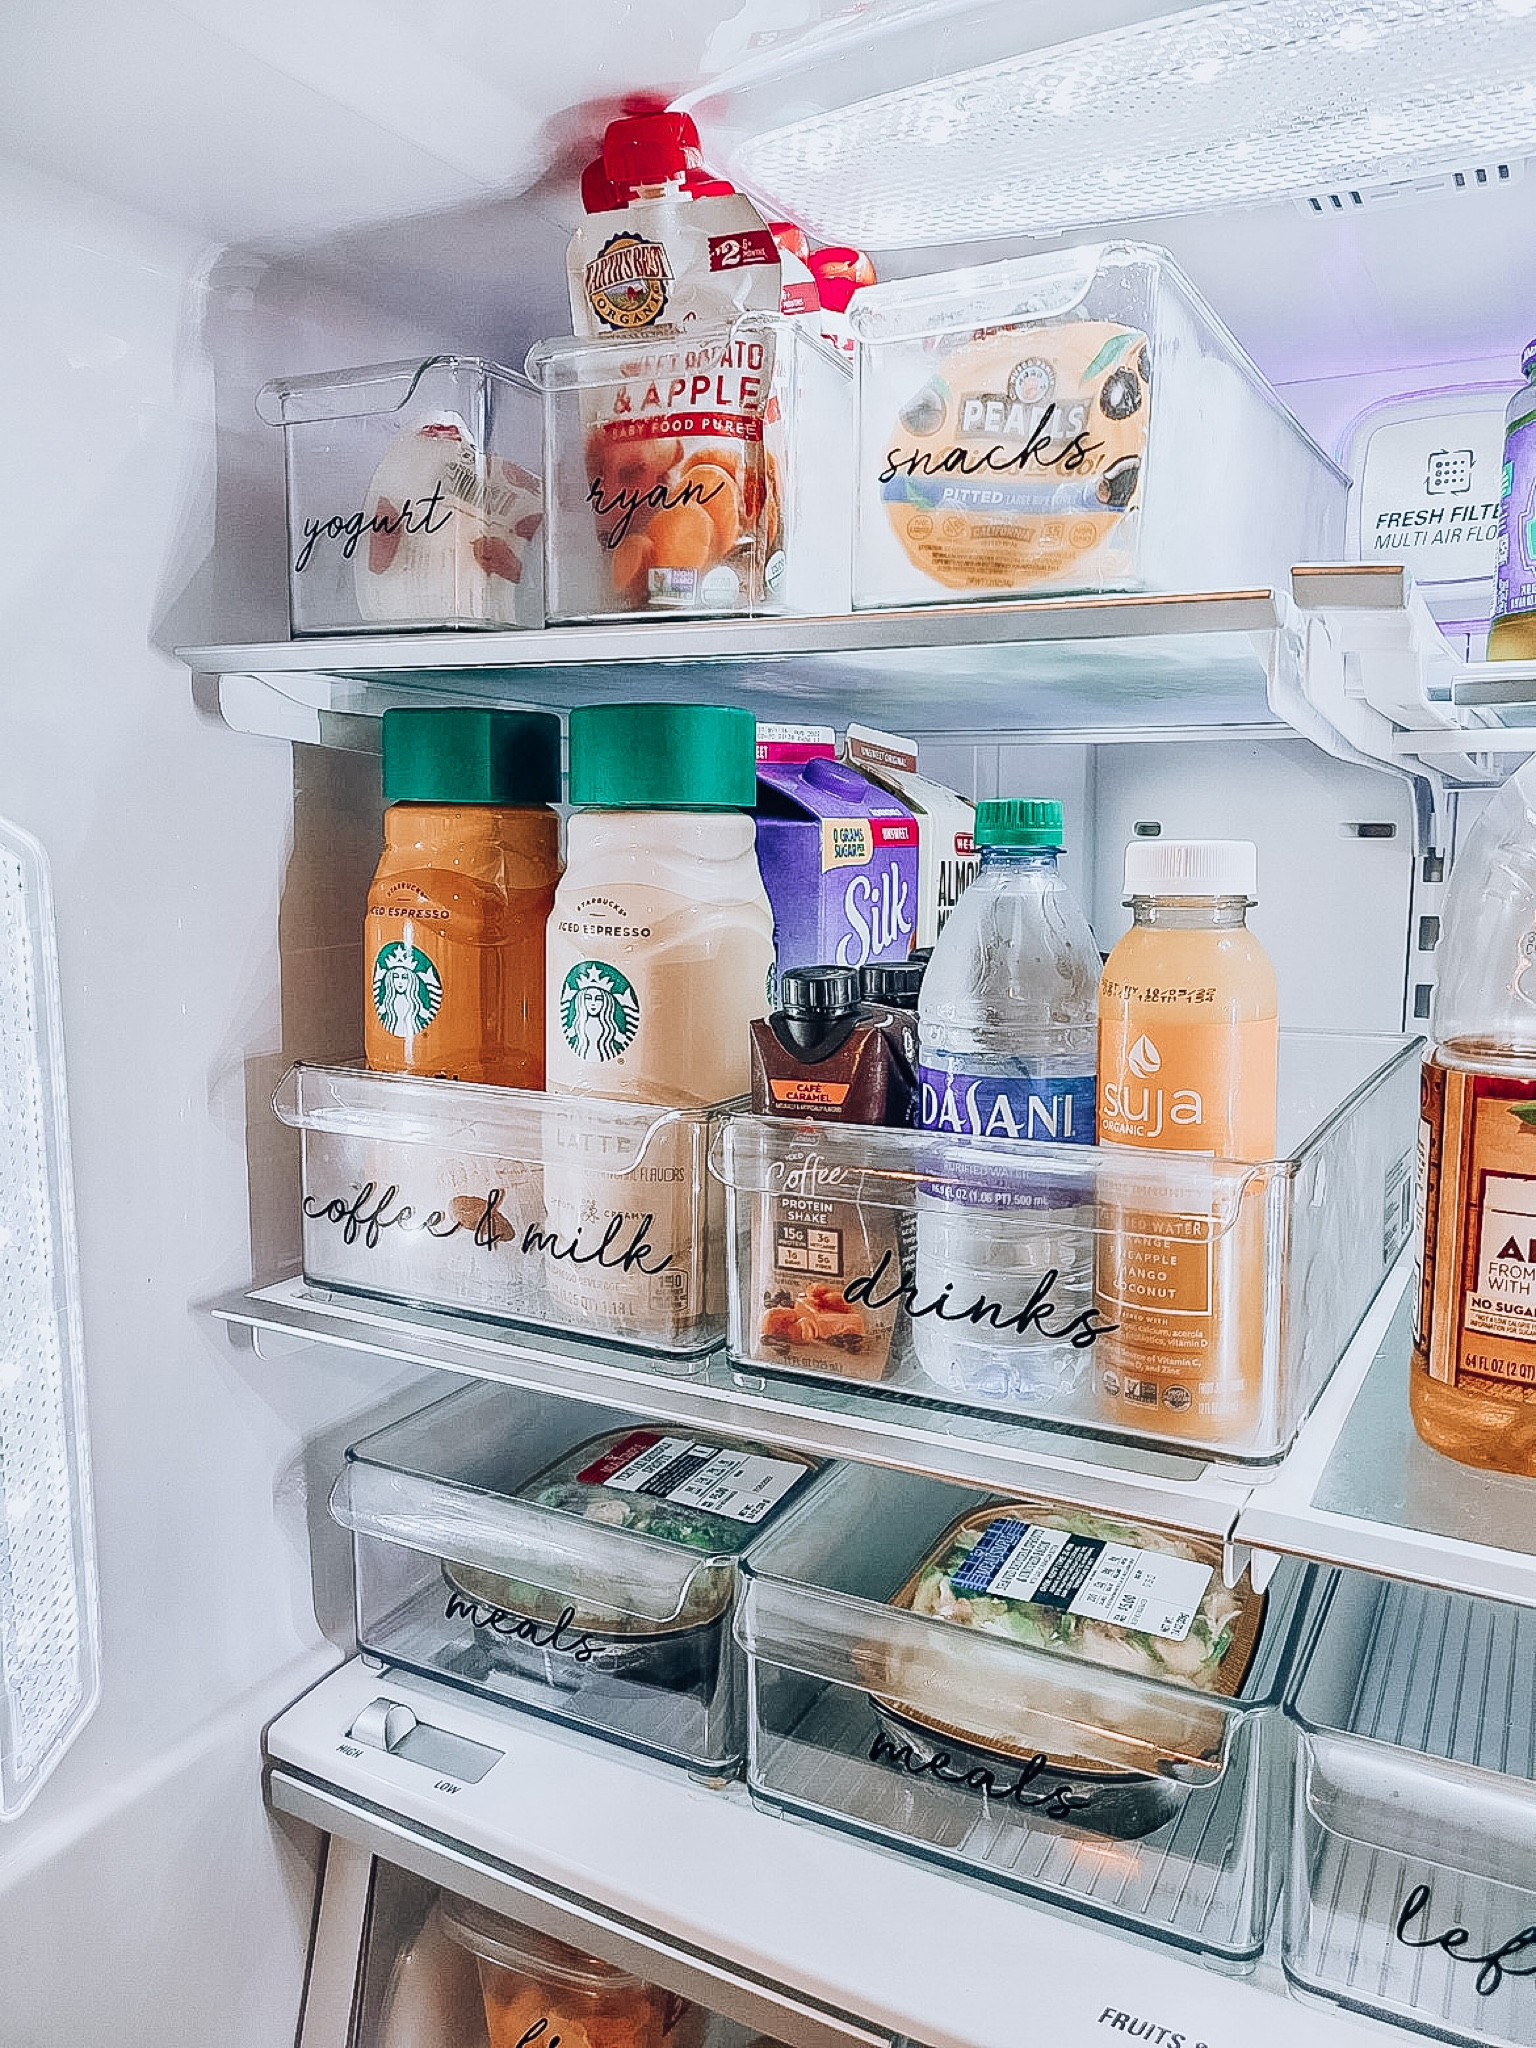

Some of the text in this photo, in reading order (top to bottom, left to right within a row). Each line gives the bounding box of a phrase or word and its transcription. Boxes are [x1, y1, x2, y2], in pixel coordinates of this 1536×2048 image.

[721, 239, 740, 266] 2
[640, 374, 761, 412] APPLE
[612, 417, 758, 441] BABY FOOD PUREE
[877, 402, 1106, 485] snacks
[942, 487, 1004, 505] PITTED
[586, 477, 727, 549] ryan
[1375, 502, 1500, 530] FRESH FILTE
[295, 480, 453, 573] yogurt
[1373, 524, 1498, 550] MULTI AIR FLO
[840, 828, 865, 843] GRAMS
[937, 860, 982, 907] ALMO
[388, 906, 451, 920] ESPRESSO
[836, 862, 912, 968] Silk
[558, 921, 651, 938] ICED ESPRESSO
[786, 1092, 832, 1103] CARAMEL
[921, 1079, 1074, 1138] DASANI
[1103, 1082, 1203, 1139] suja
[1102, 1118, 1144, 1137] ORGANIC
[557, 1127, 631, 1154] LATTE
[767, 1152, 849, 1197] Coffee
[781, 1198, 833, 1213] PROTEIN
[787, 1211, 828, 1225] SHAKE
[303, 1182, 462, 1249] coffee
[521, 1214, 674, 1275] milk
[1152, 1221, 1202, 1236] WATER
[1109, 1245, 1177, 1266] PNEAPPLE
[1488, 1261, 1536, 1282] FROM
[1112, 1279, 1177, 1299] COCONUT
[1488, 1276, 1531, 1296] WITH
[843, 1250, 1120, 1348] drinks
[1471, 1296, 1536, 1318] NO SUGA
[1465, 1353, 1477, 1368] 64
[1479, 1355, 1489, 1371] FL
[1491, 1358, 1505, 1374] OZ
[444, 1593, 606, 1663] meals
[335, 1744, 365, 1759] HIGH
[433, 1779, 462, 1795] LOW
[868, 1731, 1091, 1820] meals
[1097, 2006, 1188, 2048] FRUITS
